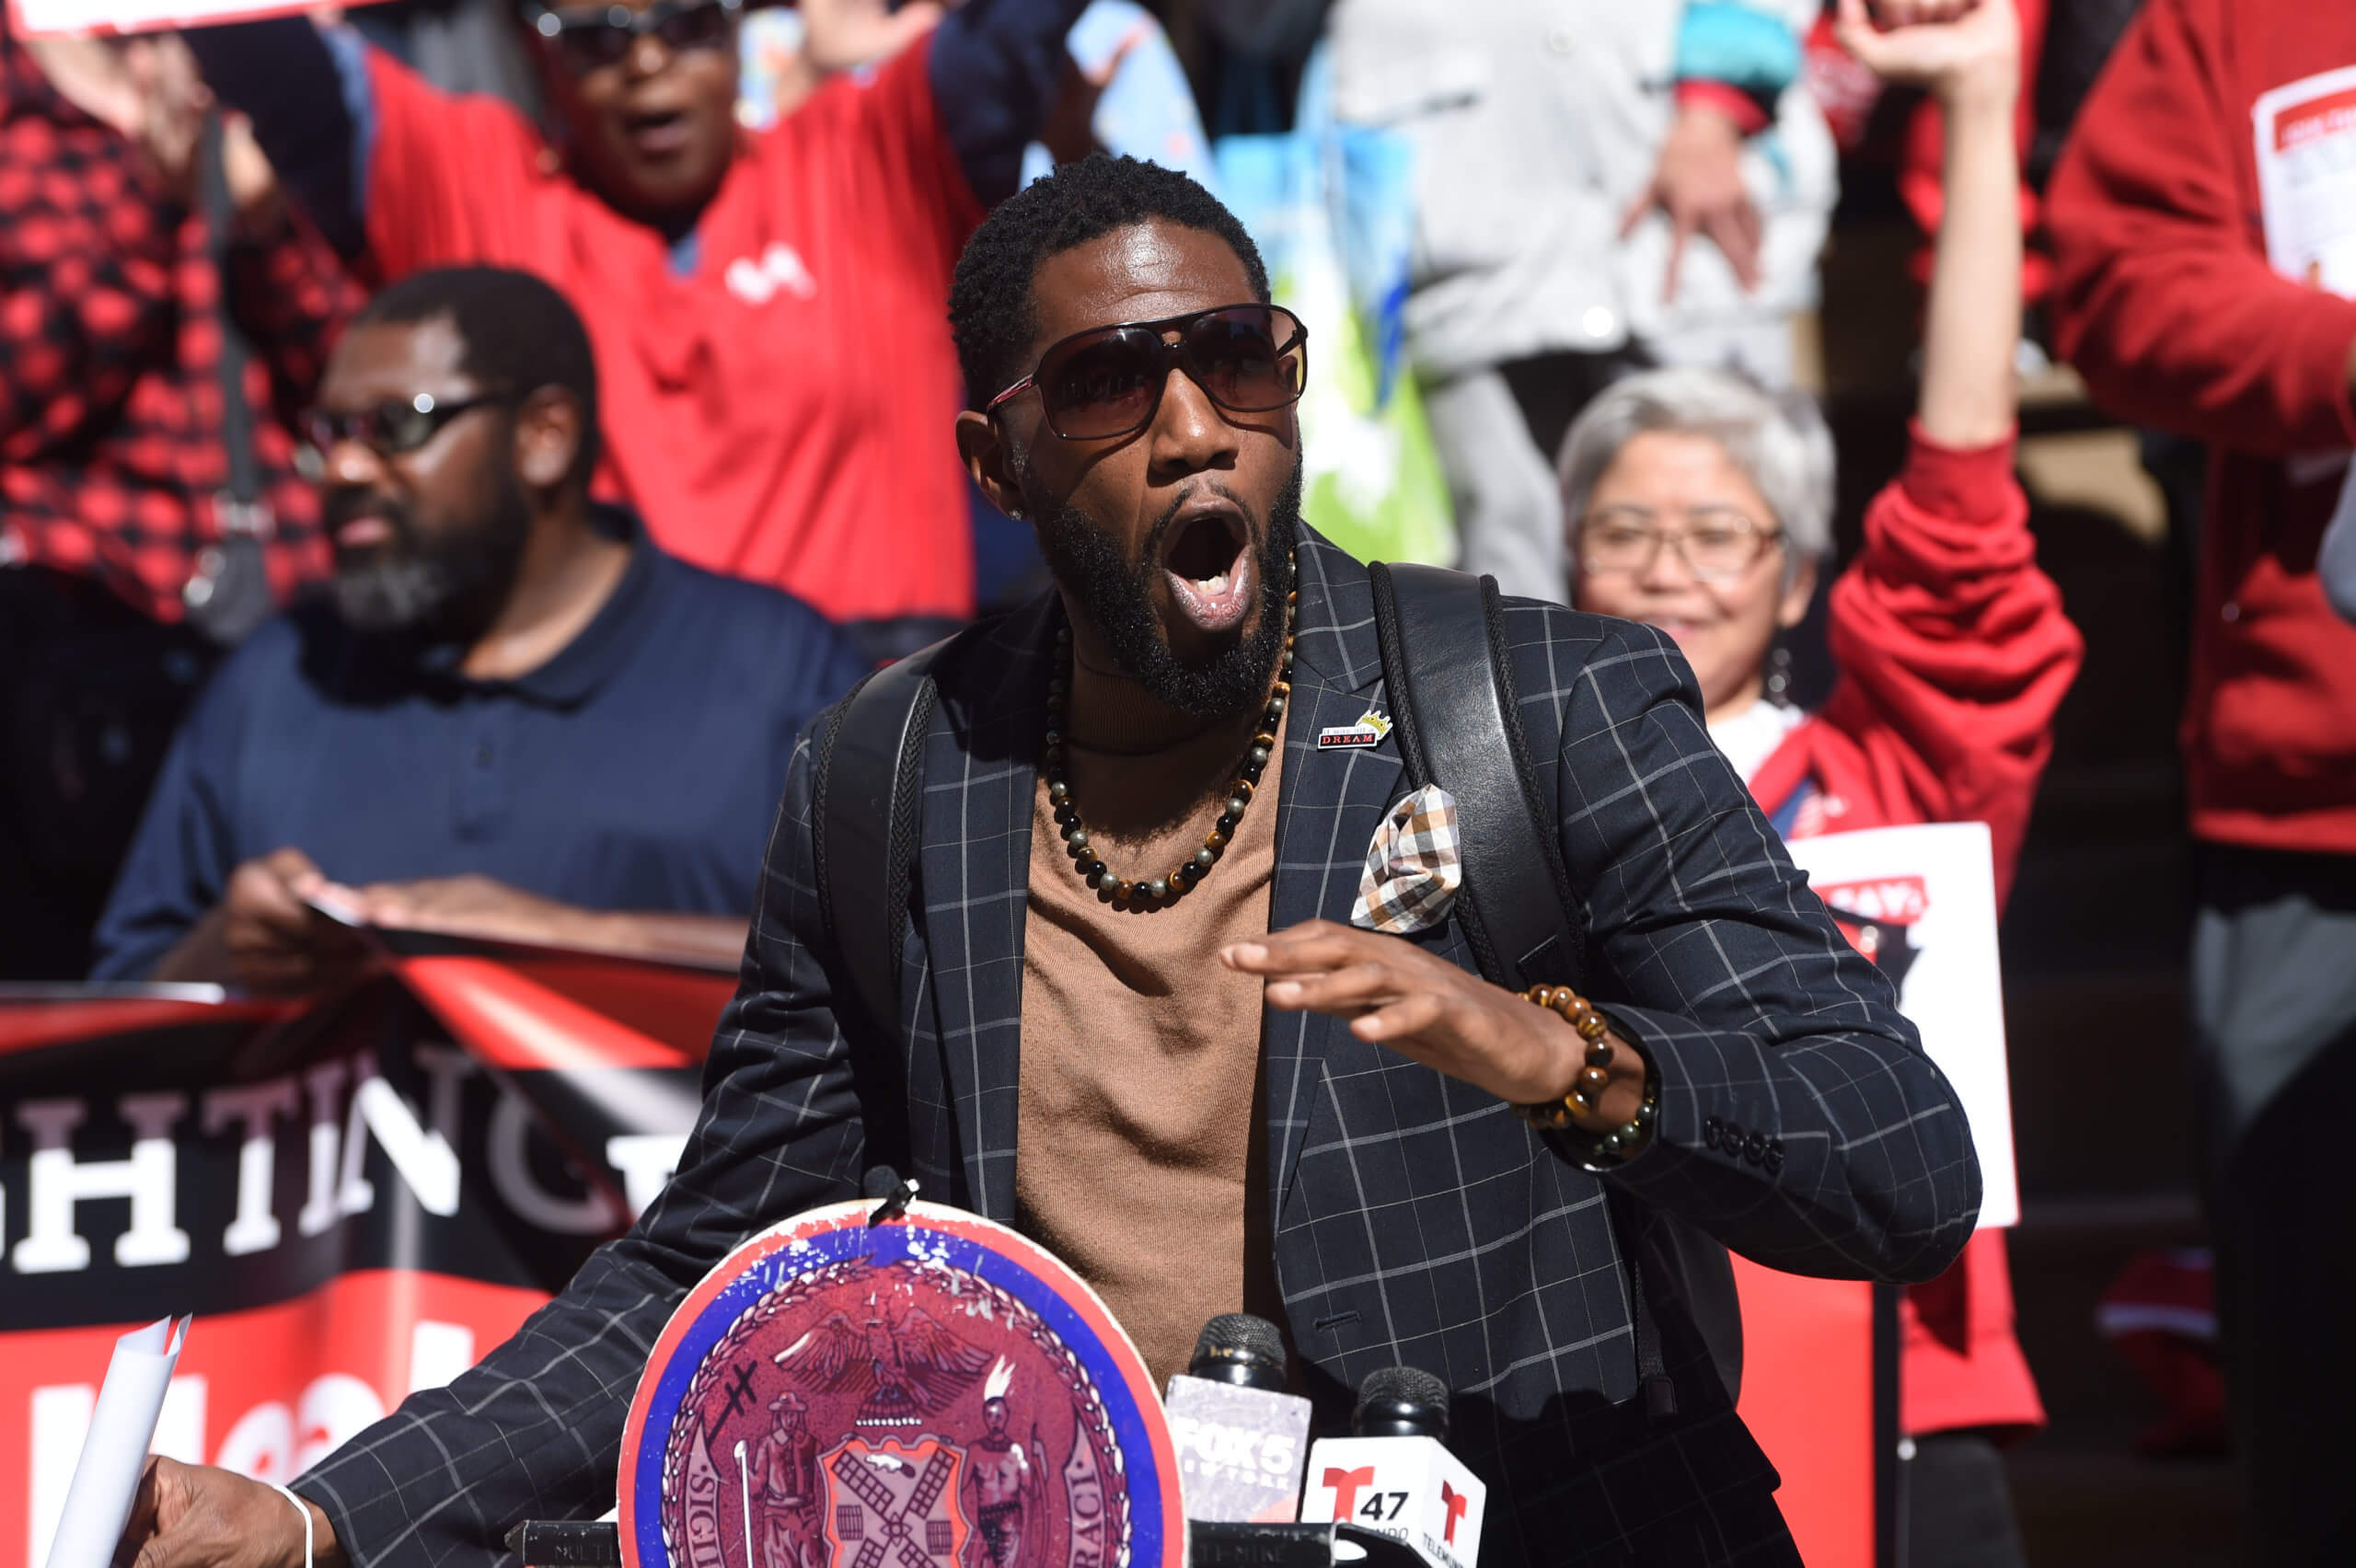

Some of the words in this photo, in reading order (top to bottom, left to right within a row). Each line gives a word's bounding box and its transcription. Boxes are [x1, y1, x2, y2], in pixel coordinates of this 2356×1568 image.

[1322, 734, 1373, 744] DREAM
[1173, 1416, 1261, 1470] FOX
[1260, 1434, 1296, 1474] 5
[1360, 1492, 1409, 1521] 47
